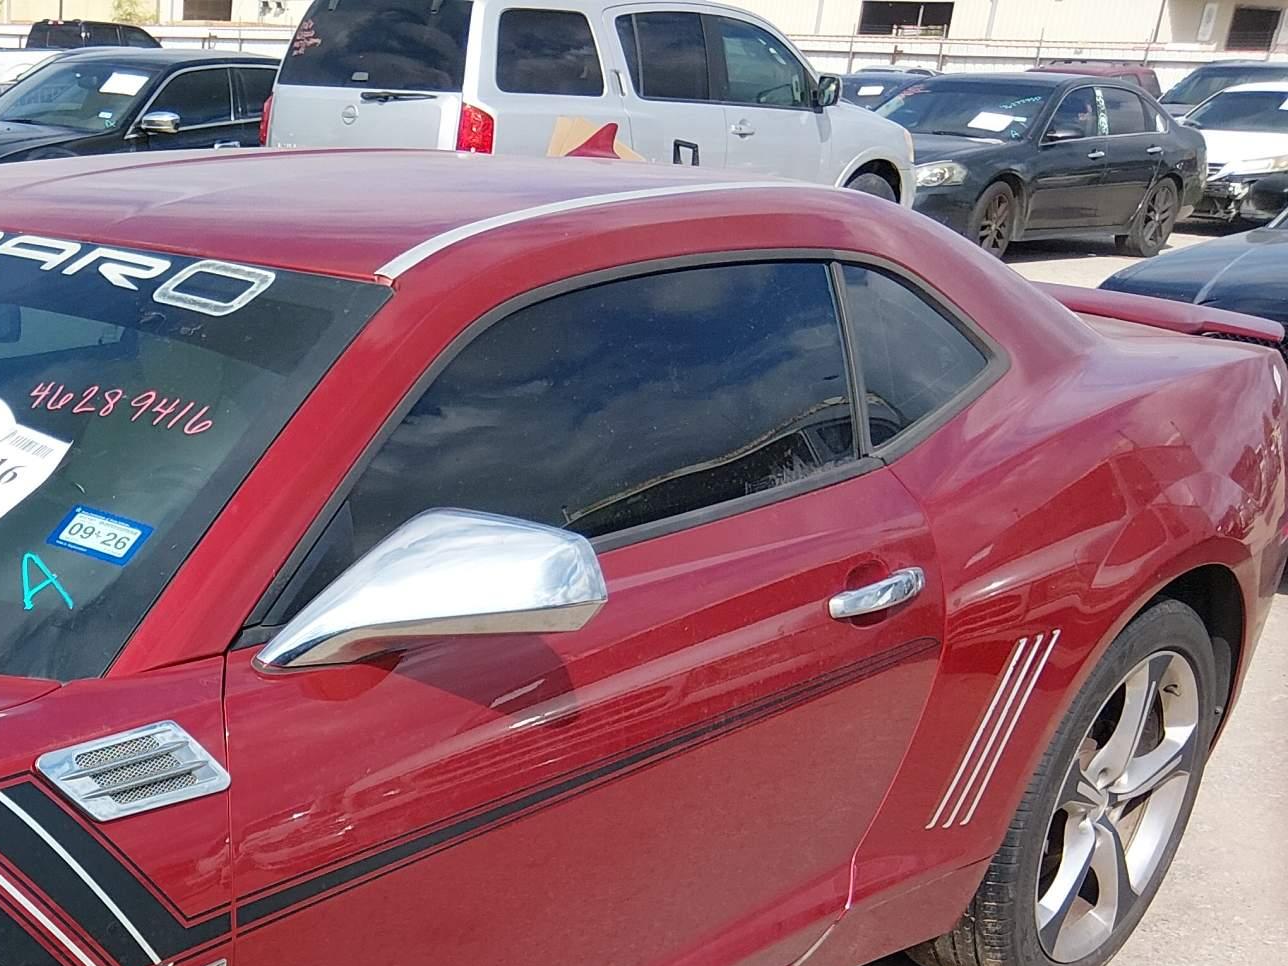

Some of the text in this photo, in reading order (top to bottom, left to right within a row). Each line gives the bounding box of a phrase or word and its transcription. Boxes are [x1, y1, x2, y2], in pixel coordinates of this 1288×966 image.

[29, 381, 213, 435] 46289416
[99, 531, 131, 551] 26
[21, 552, 75, 612] A
